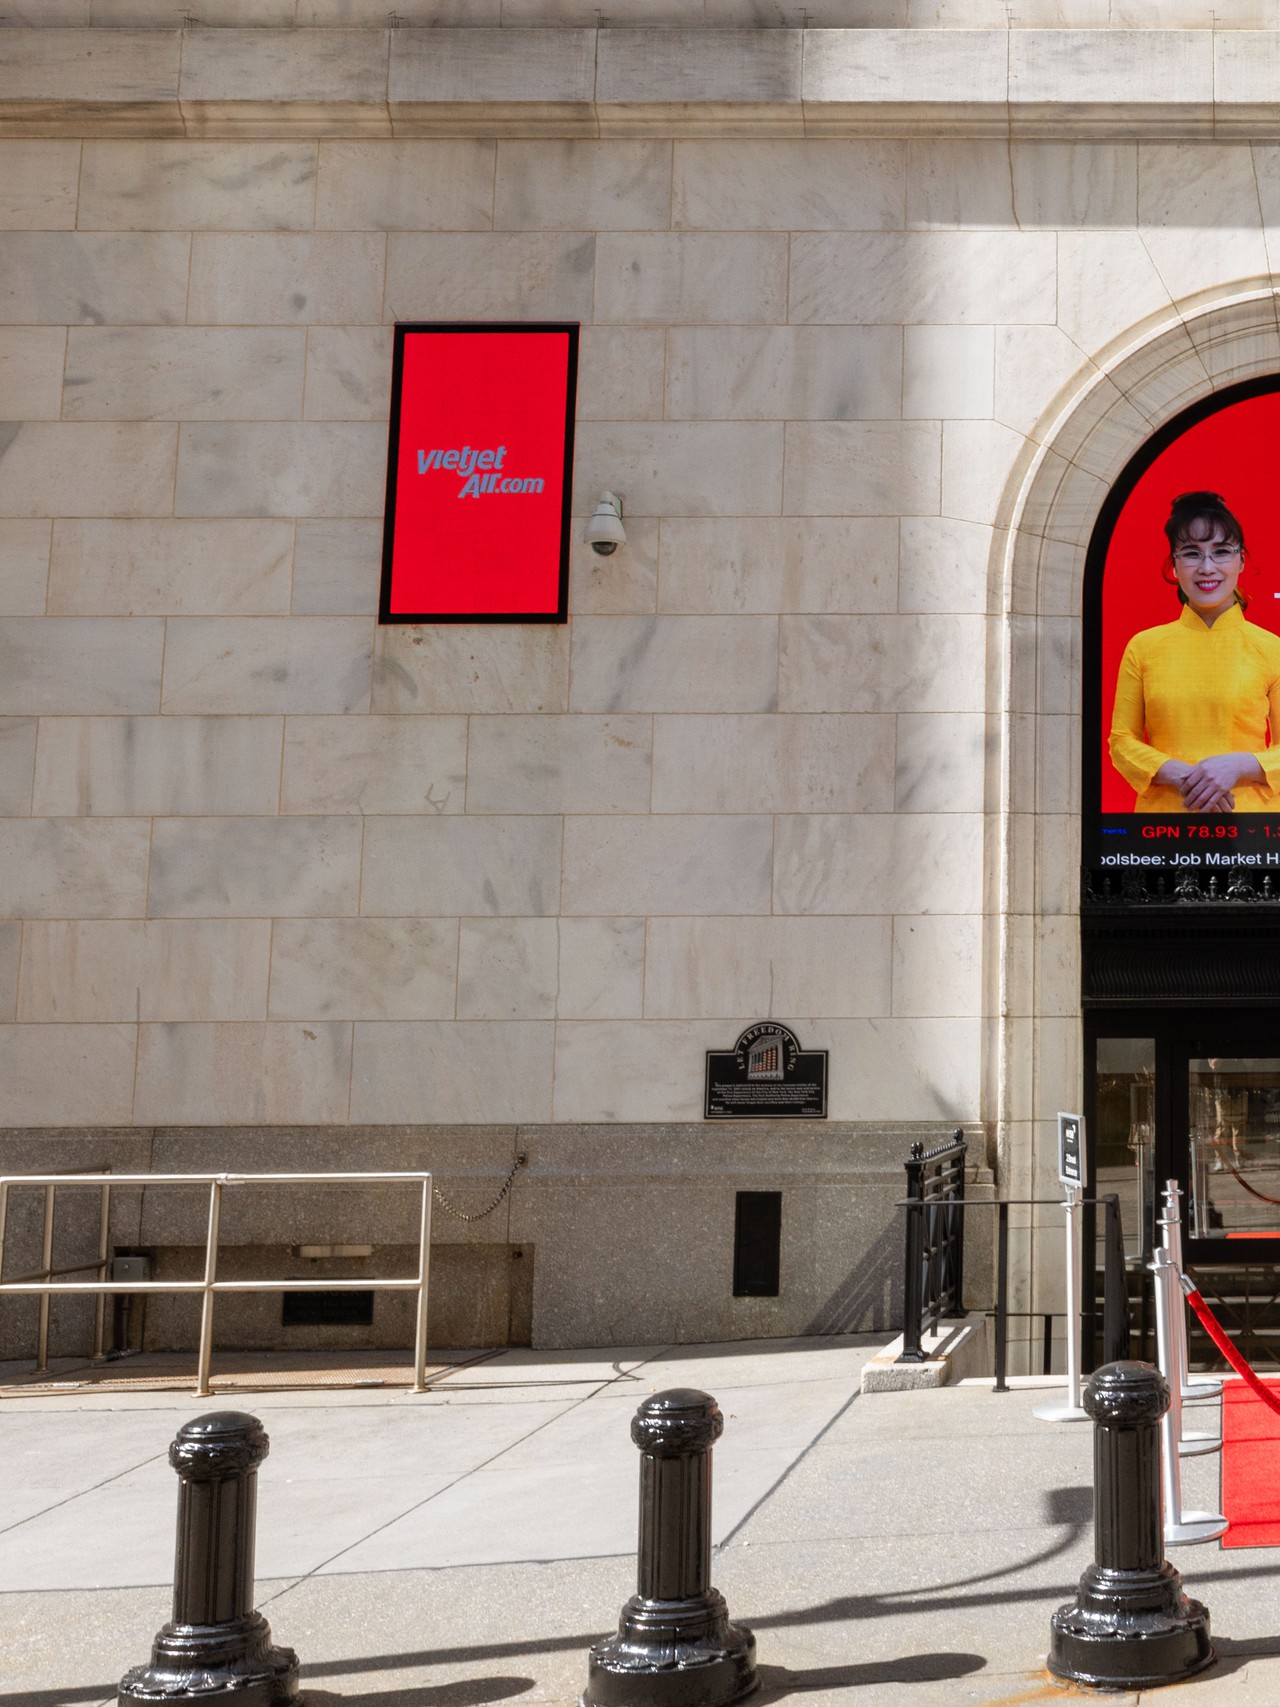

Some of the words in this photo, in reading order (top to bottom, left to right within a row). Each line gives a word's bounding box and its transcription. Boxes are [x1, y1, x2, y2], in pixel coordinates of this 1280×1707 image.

[1141, 825, 1180, 839] GPN
[1187, 825, 1239, 839] 78.93
[1169, 853, 1202, 866] Job
[1205, 852, 1262, 865] Market
[737, 1050, 745, 1070] LET
[742, 1026, 790, 1045] FREEDOM
[787, 1045, 796, 1071] RING
